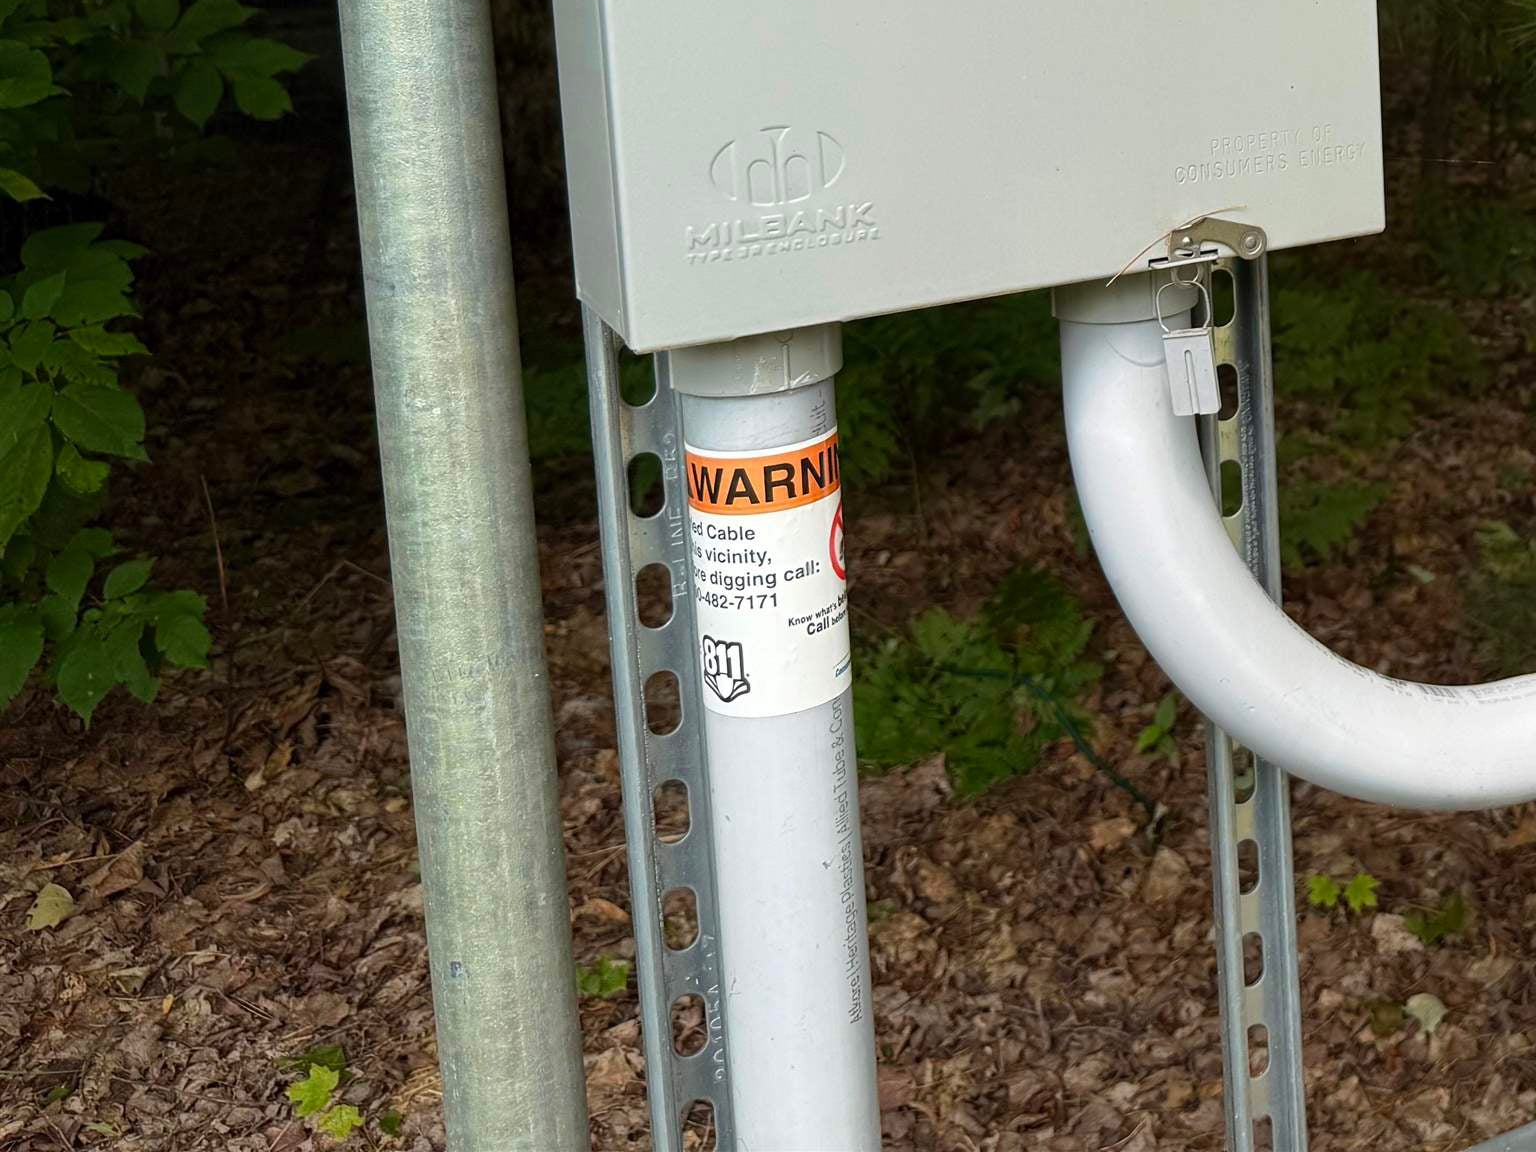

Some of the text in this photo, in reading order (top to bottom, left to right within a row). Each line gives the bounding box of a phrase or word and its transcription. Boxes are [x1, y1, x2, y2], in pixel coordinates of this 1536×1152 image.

[1209, 123, 1333, 157] PROPERTY OF
[1174, 141, 1367, 185] CONSUMERS ENERGY
[685, 200, 877, 251] MILBANK
[707, 524, 756, 541] Cable
[705, 547, 773, 567] vicinity,
[710, 570, 777, 591] digging
[784, 559, 821, 582] call:
[788, 614, 813, 628] Know
[815, 602, 838, 619] what's
[807, 616, 830, 636] Call
[703, 636, 743, 679] 811
[832, 749, 848, 793] Tube
[834, 791, 850, 835] Allied
[842, 901, 862, 973] Heritage
